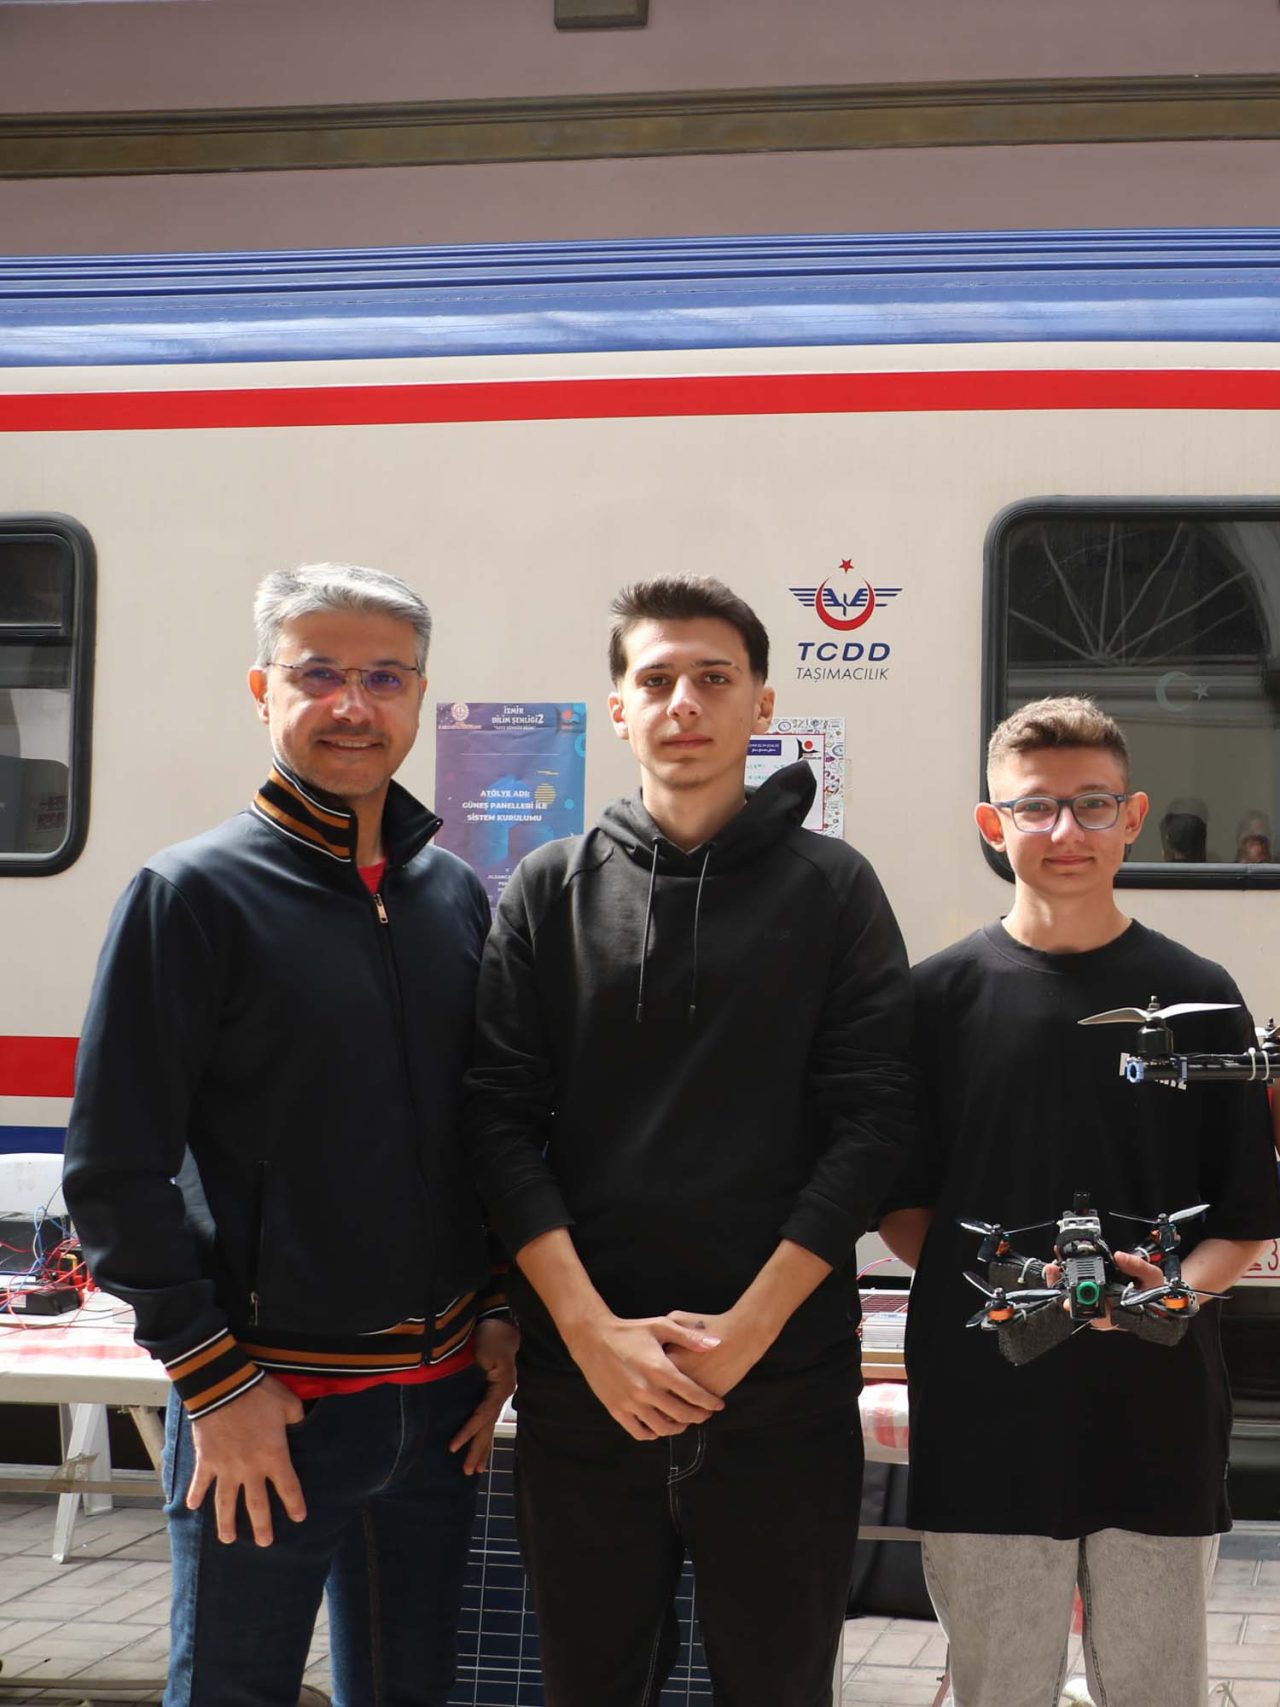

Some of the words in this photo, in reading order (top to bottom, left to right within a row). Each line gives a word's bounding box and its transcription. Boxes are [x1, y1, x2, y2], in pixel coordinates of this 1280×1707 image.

[797, 642, 891, 662] TCDD
[796, 667, 891, 683] TAŞIMACILIK
[503, 705, 524, 714] İZMİR
[491, 714, 511, 724] BİLİM
[480, 789, 511, 797] ATÖLYE
[462, 801, 488, 810] GÜNEŞ
[490, 801, 533, 809] PANELLERİ
[535, 800, 547, 809] İLE
[467, 812, 495, 821] SİSTEM
